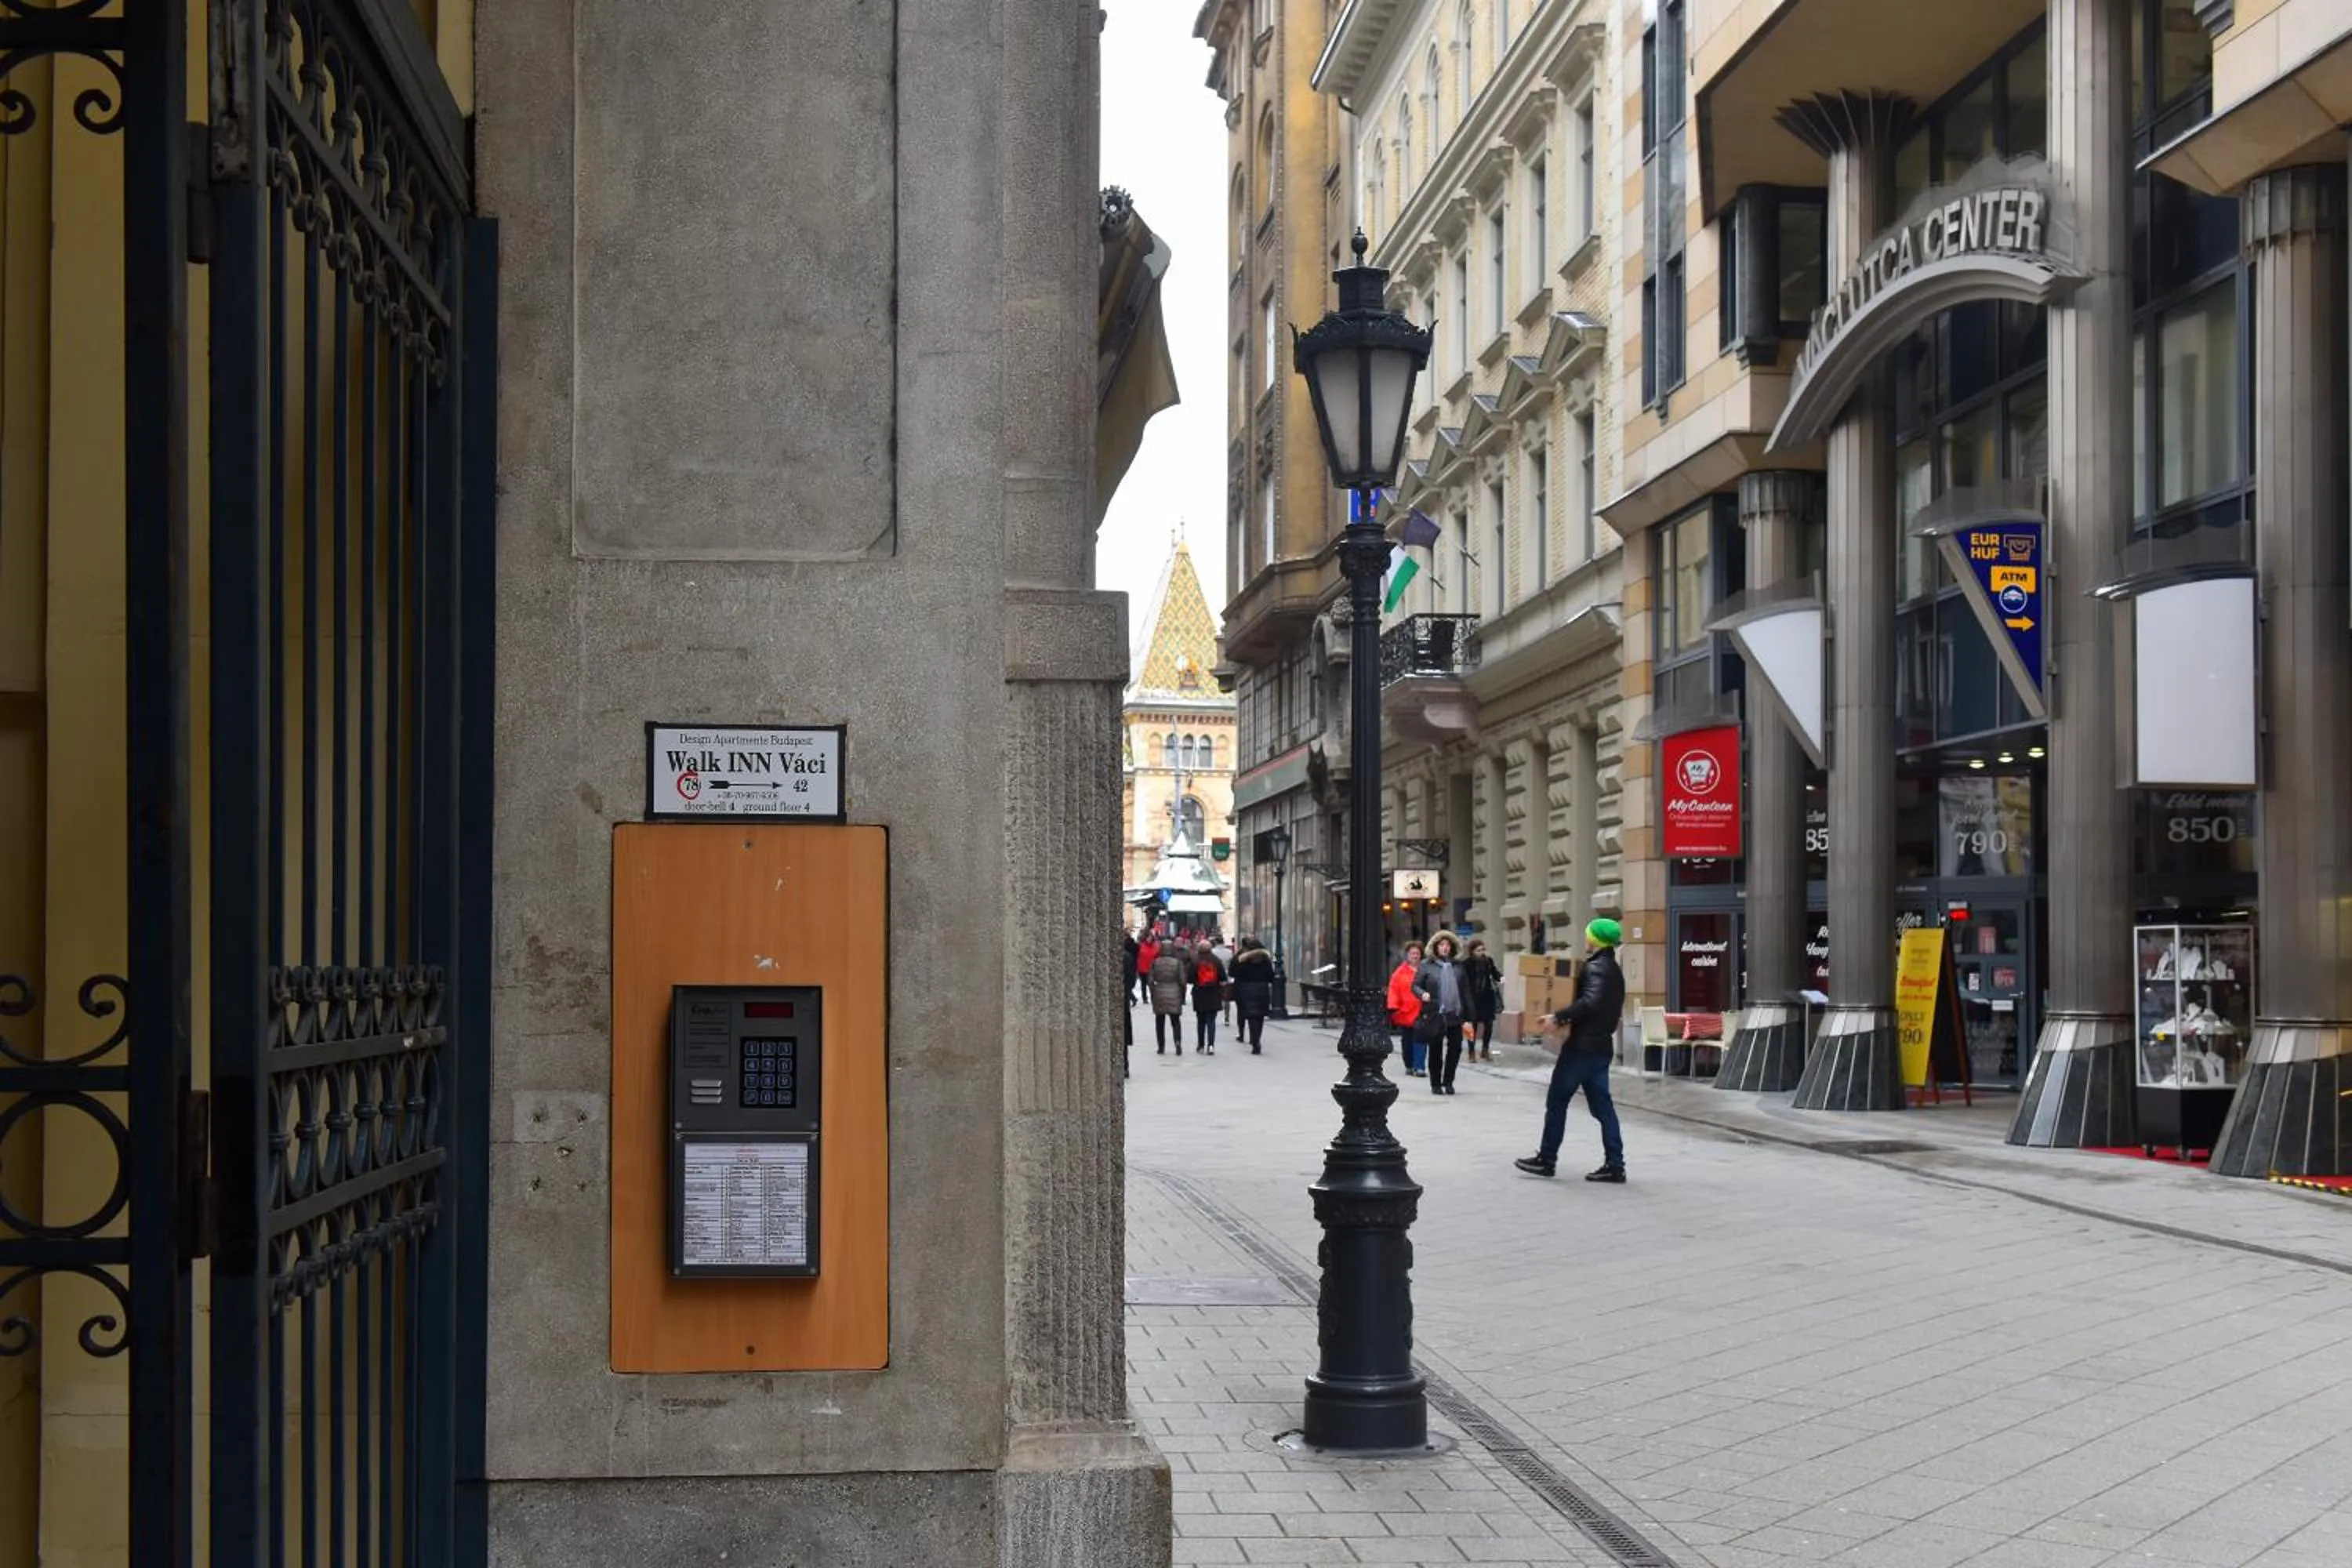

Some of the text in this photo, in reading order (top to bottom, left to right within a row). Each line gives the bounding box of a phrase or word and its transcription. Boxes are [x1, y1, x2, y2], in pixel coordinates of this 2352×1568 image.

[1846, 225, 1915, 311] UTCA
[1924, 188, 2045, 261] CENTER
[1970, 532, 1999, 546] EUR
[1970, 546, 2000, 559] HUF
[2000, 572, 2028, 582] ATM
[680, 734, 814, 746] Design Apartments Budapest
[666, 750, 826, 774] Walk INN Váci
[793, 779, 808, 793] 42
[728, 802, 735, 811] 4
[742, 802, 777, 813] ground
[779, 802, 802, 812] floor
[804, 802, 811, 813] 4
[1668, 799, 1733, 815] MyCanteen
[2168, 815, 2235, 843] 850
[1955, 829, 2007, 856] 790
[1897, 1028, 1922, 1044] 90
